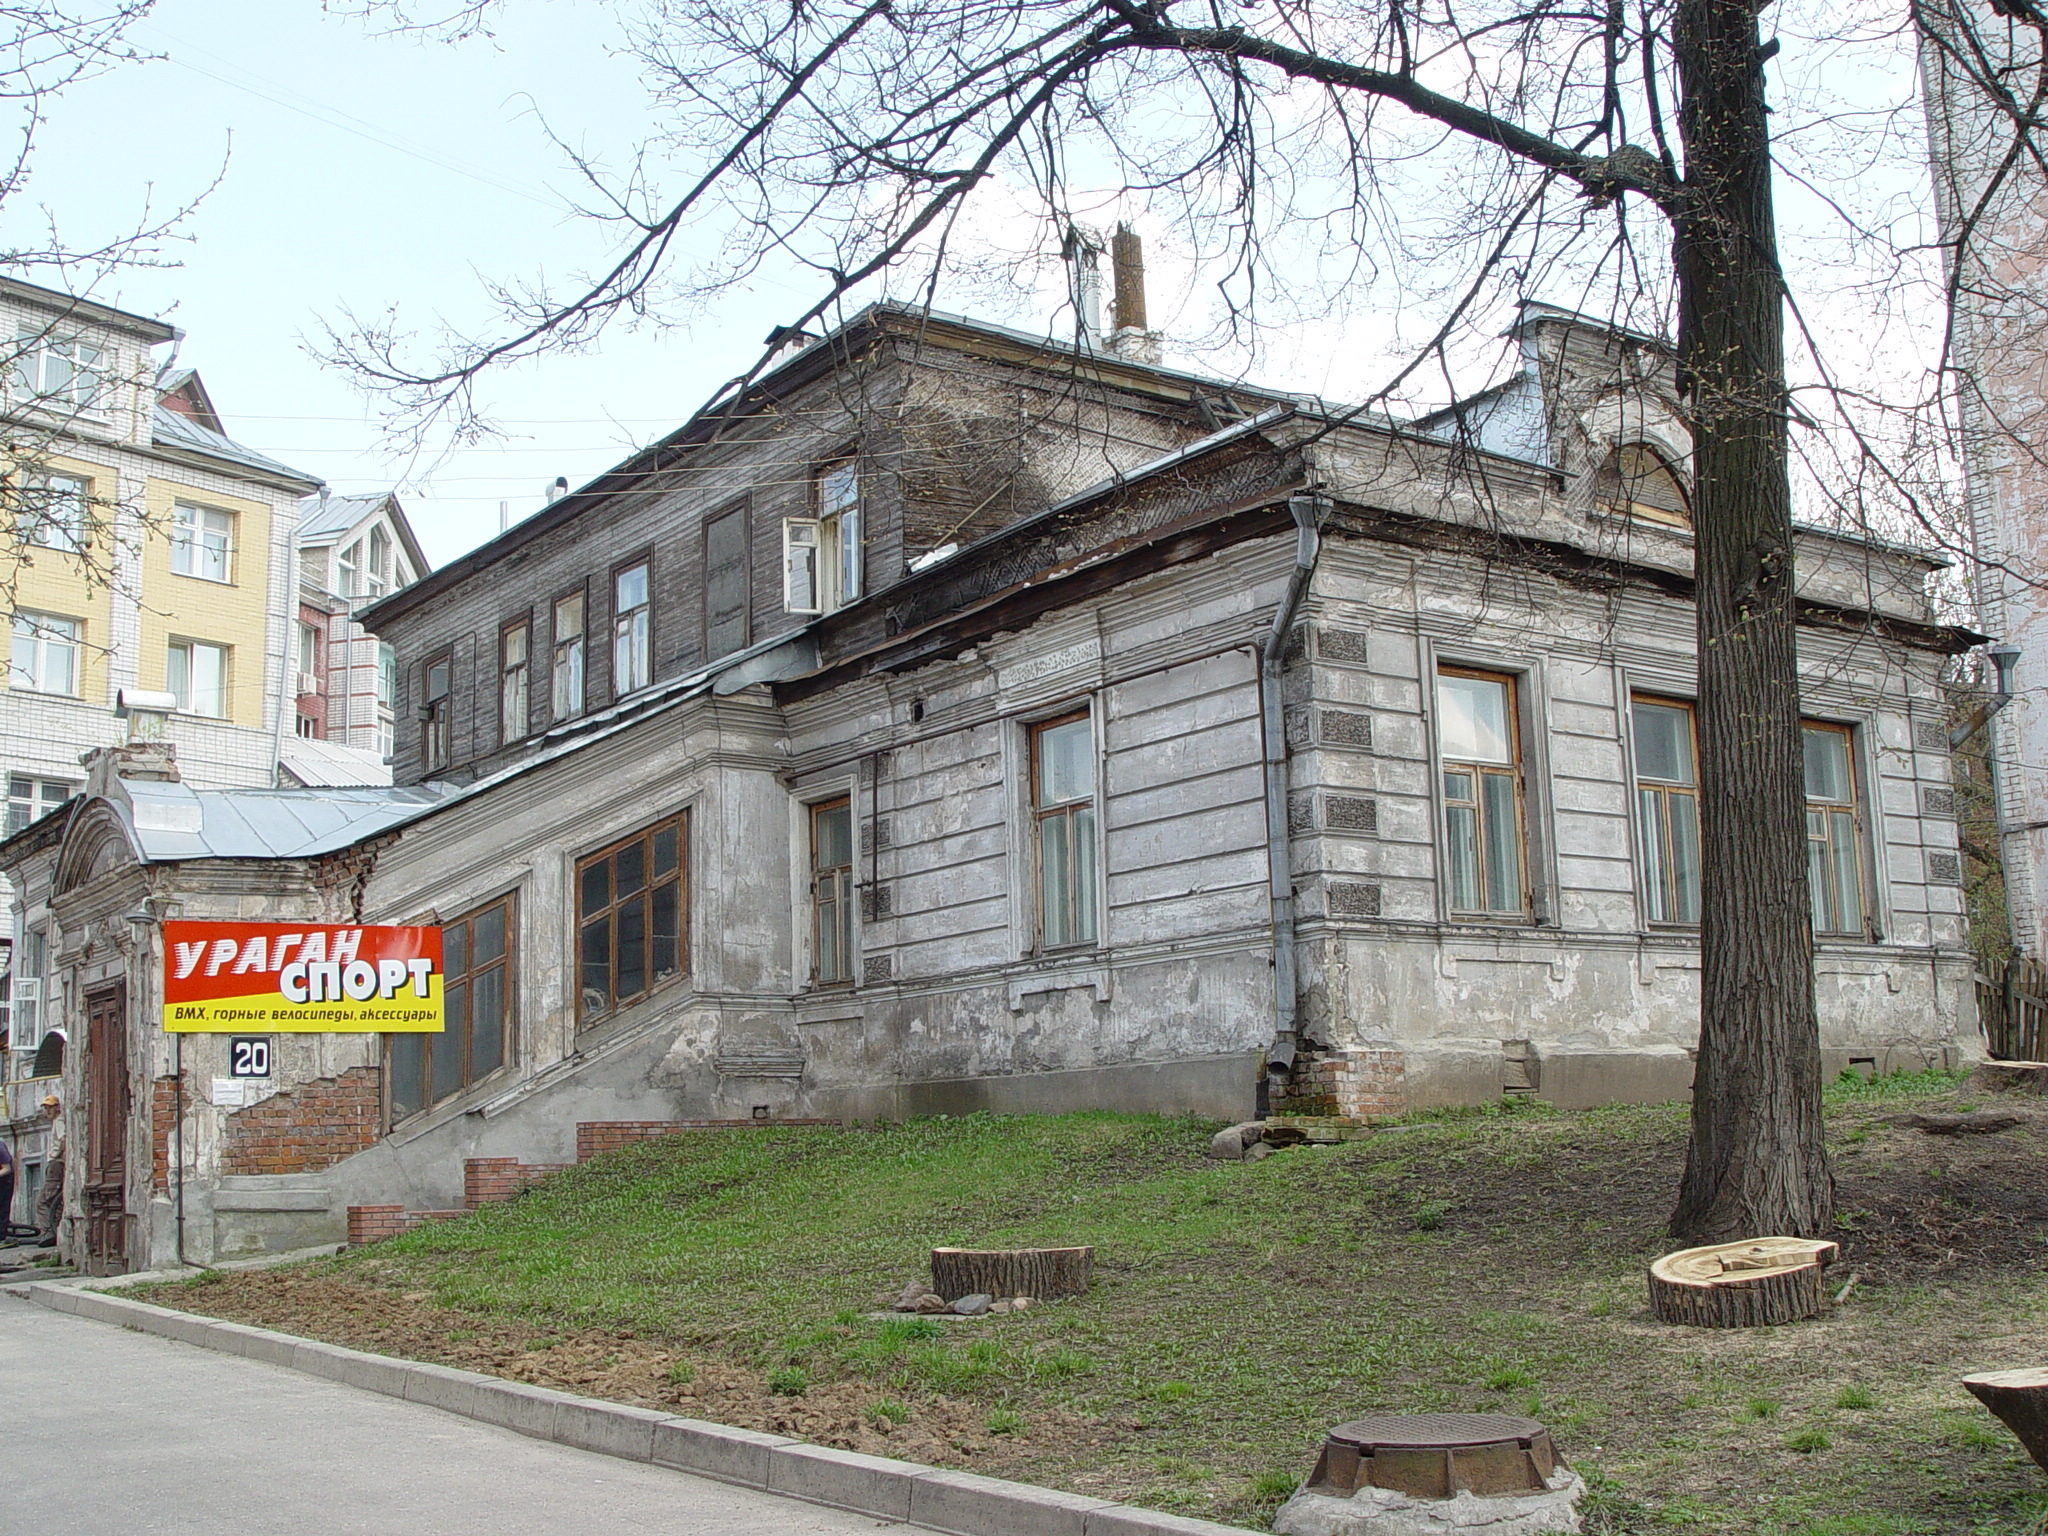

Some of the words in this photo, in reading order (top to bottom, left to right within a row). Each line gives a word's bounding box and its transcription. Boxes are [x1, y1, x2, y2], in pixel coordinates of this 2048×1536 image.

[173, 929, 363, 979] УРАГАН
[280, 958, 431, 1002] СПОРТ
[213, 1009, 266, 1022] горные
[271, 1009, 357, 1022] велосипеды,
[360, 1008, 437, 1022] аксессуары
[235, 1042, 268, 1074] 20
